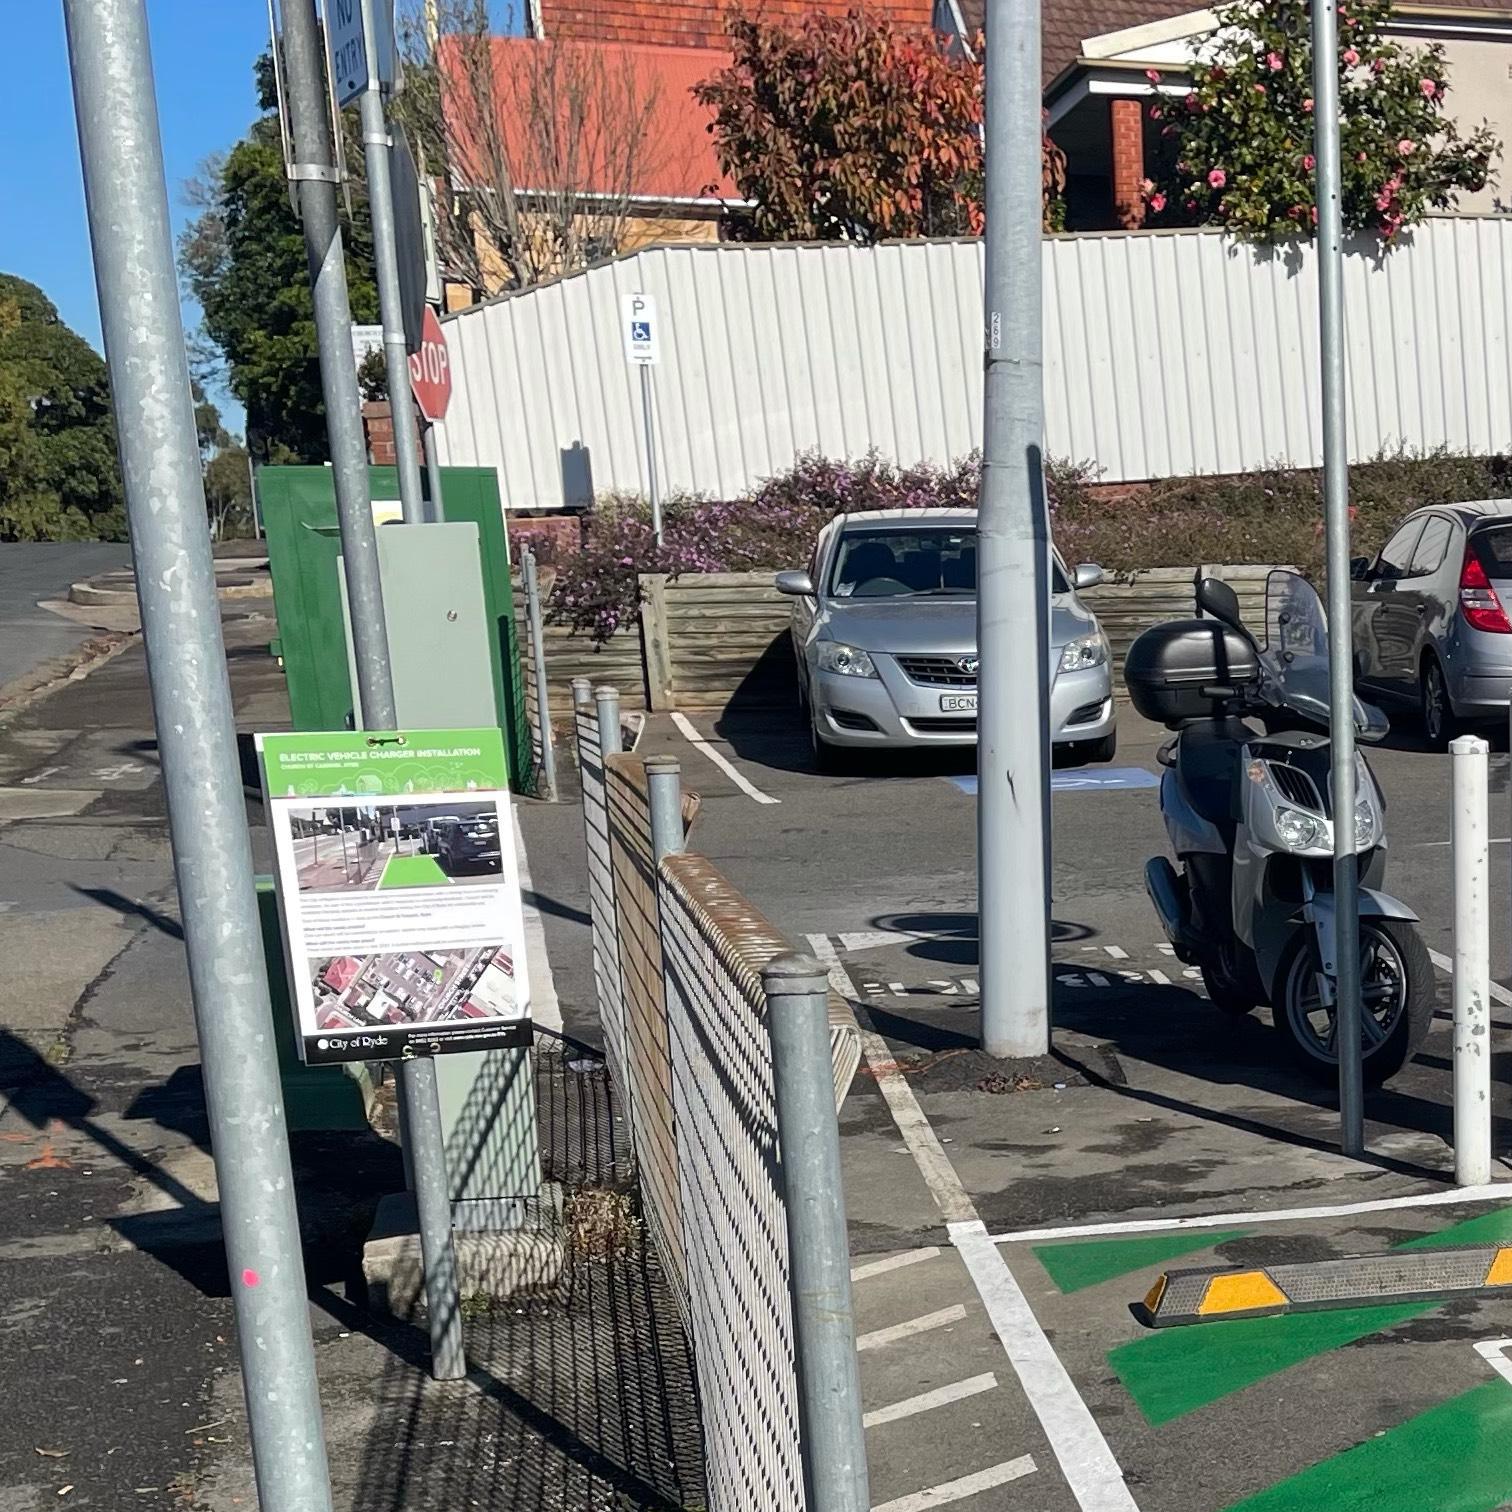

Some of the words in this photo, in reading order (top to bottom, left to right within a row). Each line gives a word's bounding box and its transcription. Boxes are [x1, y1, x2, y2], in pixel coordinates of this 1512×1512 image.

[336, 0, 353, 29] NO
[335, 37, 362, 84] ENTRY
[632, 300, 645, 316] P
[411, 341, 447, 385] STOP
[279, 752, 326, 762] ELECTRIC
[327, 752, 367, 761] VEHICLE
[369, 750, 415, 760] CHARGER
[417, 748, 480, 757] INSTALLATION
[329, 1038, 348, 1051] City
[350, 1037, 361, 1048] of
[362, 1035, 388, 1048] Ryde
